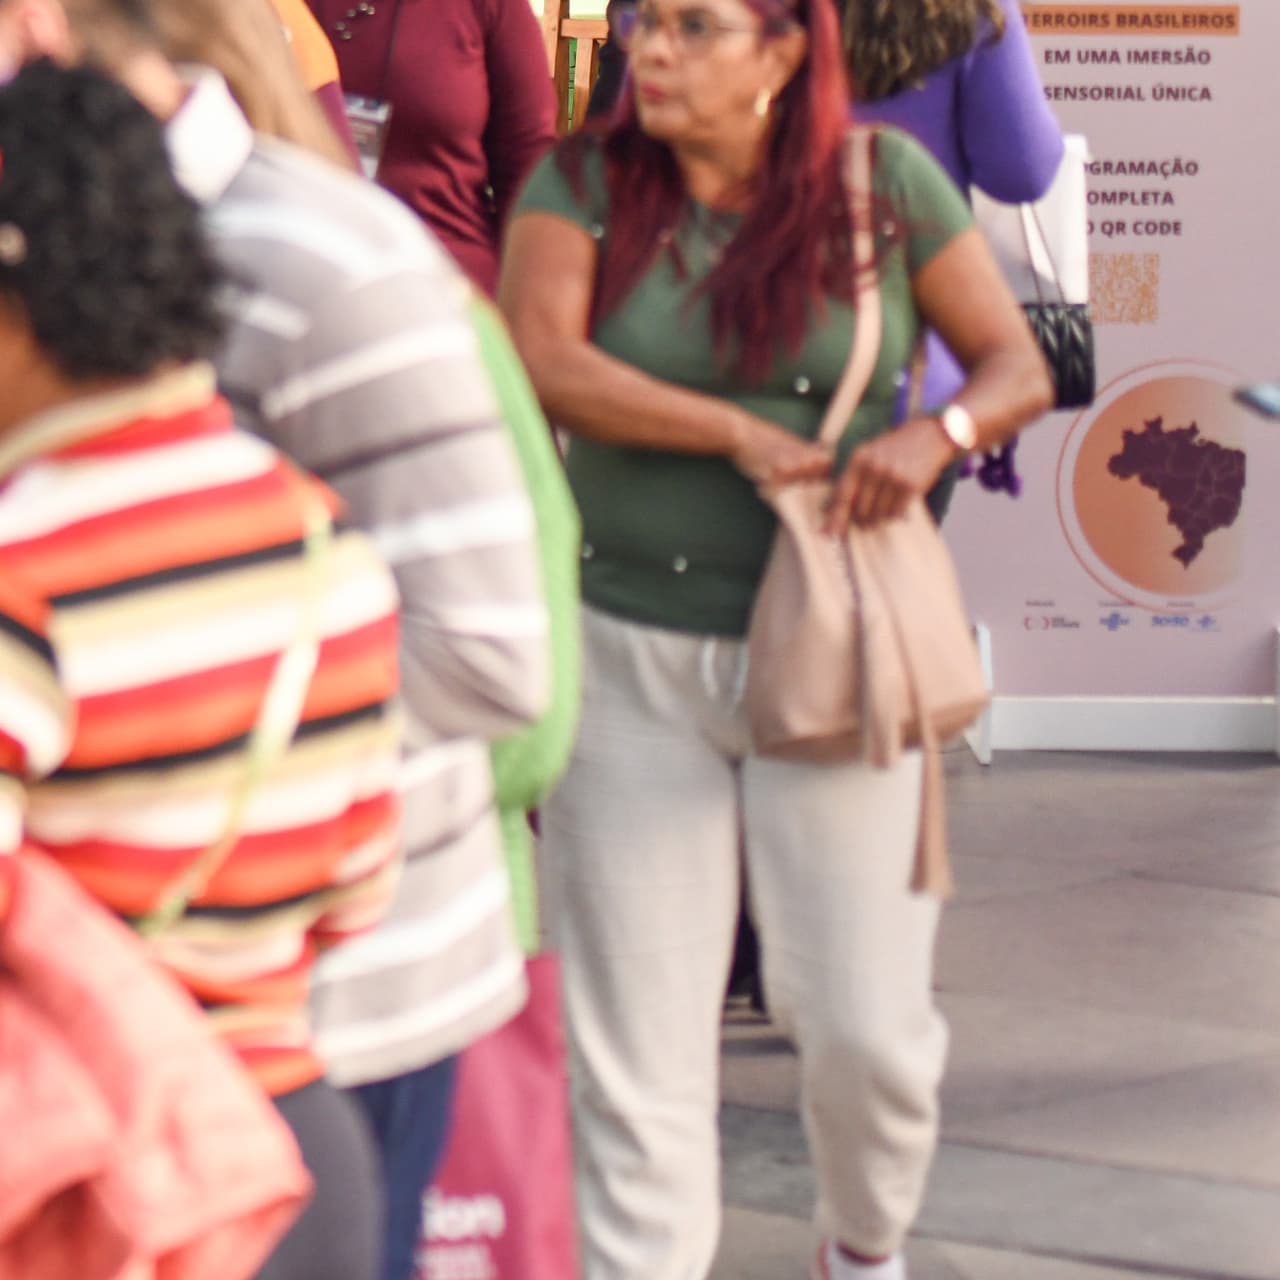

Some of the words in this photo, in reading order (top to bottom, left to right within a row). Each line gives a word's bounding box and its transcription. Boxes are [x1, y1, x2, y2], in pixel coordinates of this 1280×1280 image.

[1116, 13, 1236, 29] BRASILEIROS
[1043, 49, 1071, 64] EM
[1076, 49, 1122, 64] UMA
[1127, 46, 1211, 65] IMERSÃO
[1043, 86, 1146, 102] SENSORIAL
[1151, 82, 1212, 102] ÚNICA
[1084, 158, 1199, 181] GRAMAÇÃO
[1087, 191, 1175, 206] OMPLETA
[1100, 220, 1127, 237] QR
[1132, 220, 1182, 236] CODE
